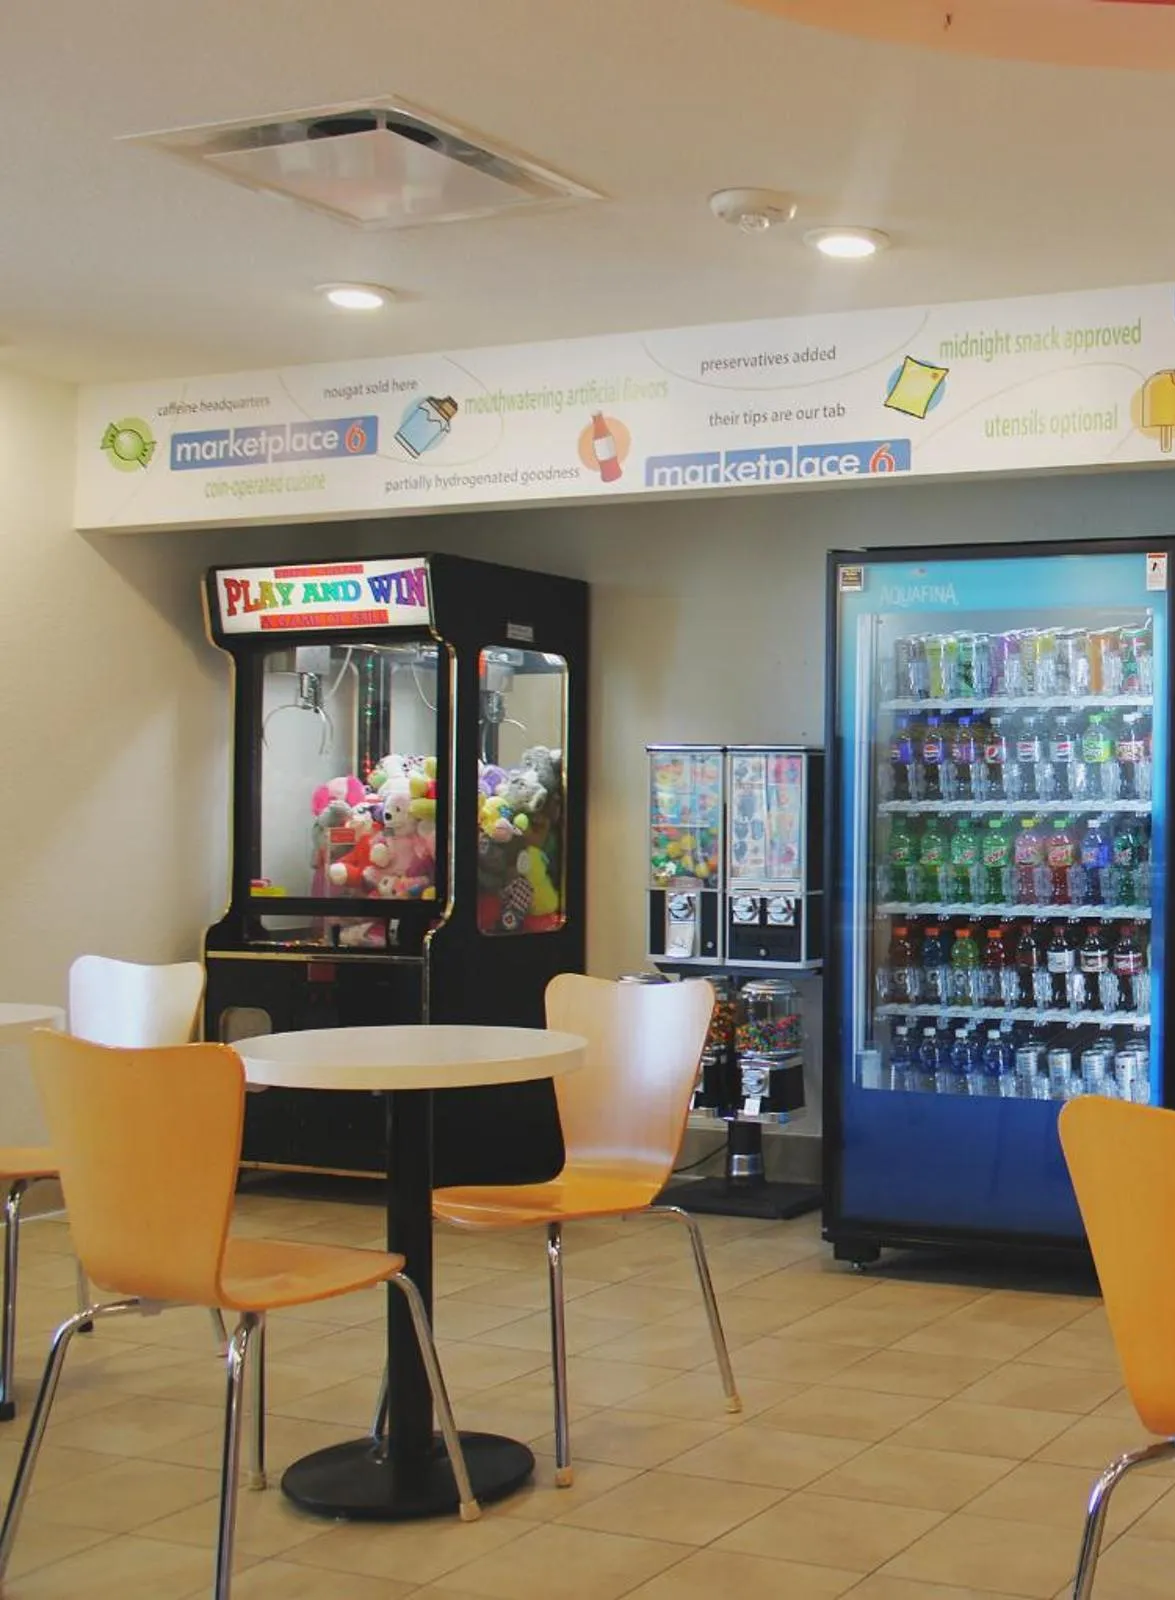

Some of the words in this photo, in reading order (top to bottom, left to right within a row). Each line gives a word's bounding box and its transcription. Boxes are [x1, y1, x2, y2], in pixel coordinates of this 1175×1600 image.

[939, 327, 1011, 361] midnight
[1014, 323, 1060, 353] snack
[1063, 318, 1142, 354] approved
[700, 349, 789, 374] preservatives
[791, 346, 837, 364] added
[323, 384, 364, 400] nougat
[366, 381, 390, 396] sold
[391, 378, 418, 392] here
[464, 385, 564, 414] mouthwatering
[567, 381, 621, 408] artificial
[624, 377, 669, 401] flavors
[157, 400, 198, 417] caffeine
[200, 394, 270, 414] headquarters
[708, 408, 740, 427] their
[743, 408, 769, 427] tips
[771, 409, 794, 424] are
[796, 408, 820, 423] our
[822, 402, 846, 420] tab
[983, 410, 1046, 439] utensils
[1048, 404, 1119, 437] optional
[175, 425, 339, 465] marketplace
[345, 419, 366, 454] 6
[869, 440, 895, 473] 6
[204, 475, 284, 500] coin-operated
[285, 472, 326, 492] cuisine
[384, 474, 432, 493] partially
[434, 469, 519, 490] hydrogenated
[521, 464, 580, 485] goodness
[224, 577, 295, 616] PLAY
[302, 580, 362, 603] AND
[367, 567, 427, 607] WIN
